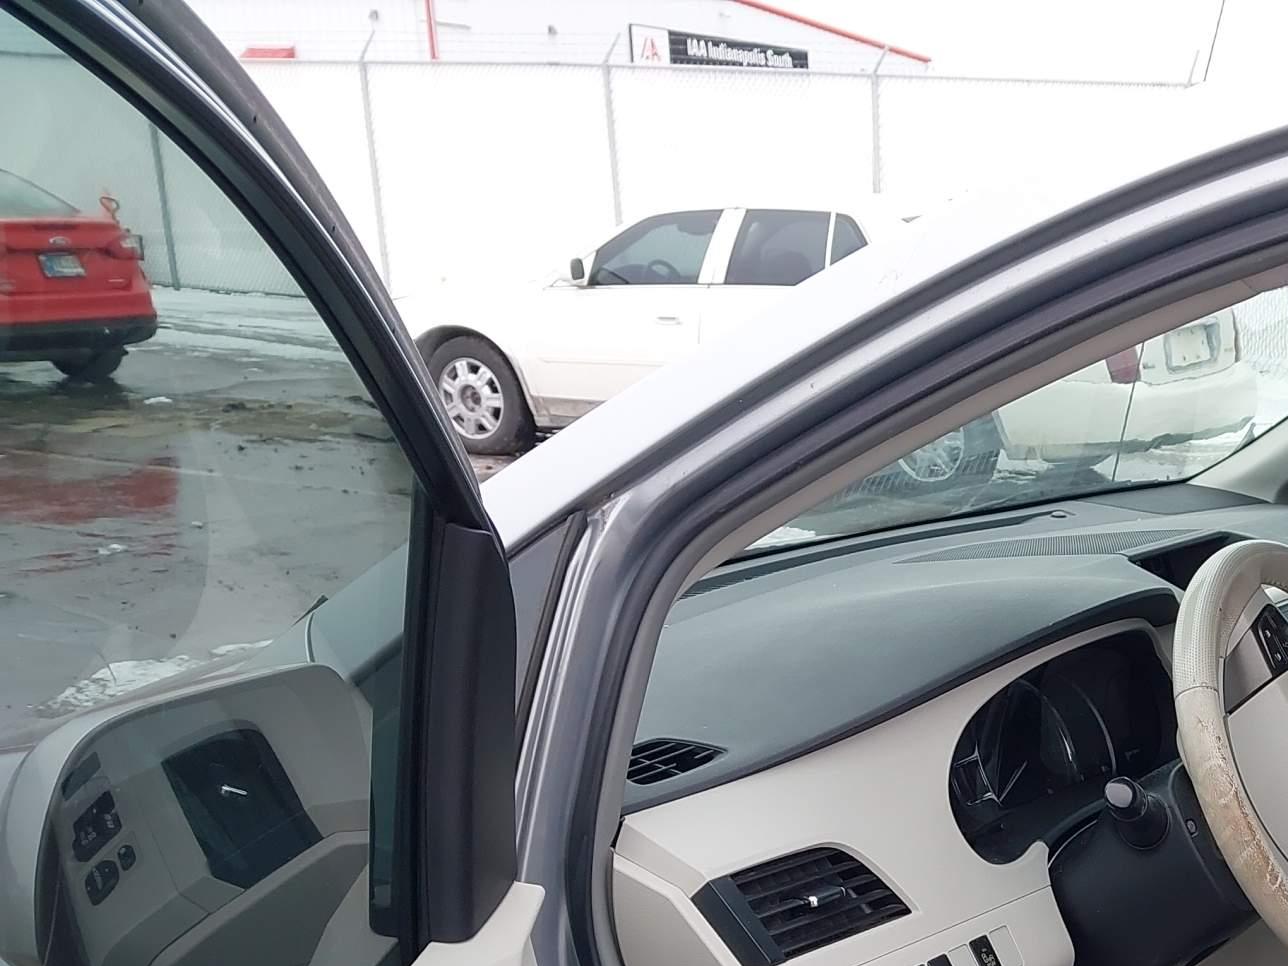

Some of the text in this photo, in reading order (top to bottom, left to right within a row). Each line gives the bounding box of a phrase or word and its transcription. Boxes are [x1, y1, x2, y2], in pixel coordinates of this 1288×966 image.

[686, 37, 708, 57] IAA
[707, 41, 766, 66] Indianapolis
[766, 49, 794, 68] South
